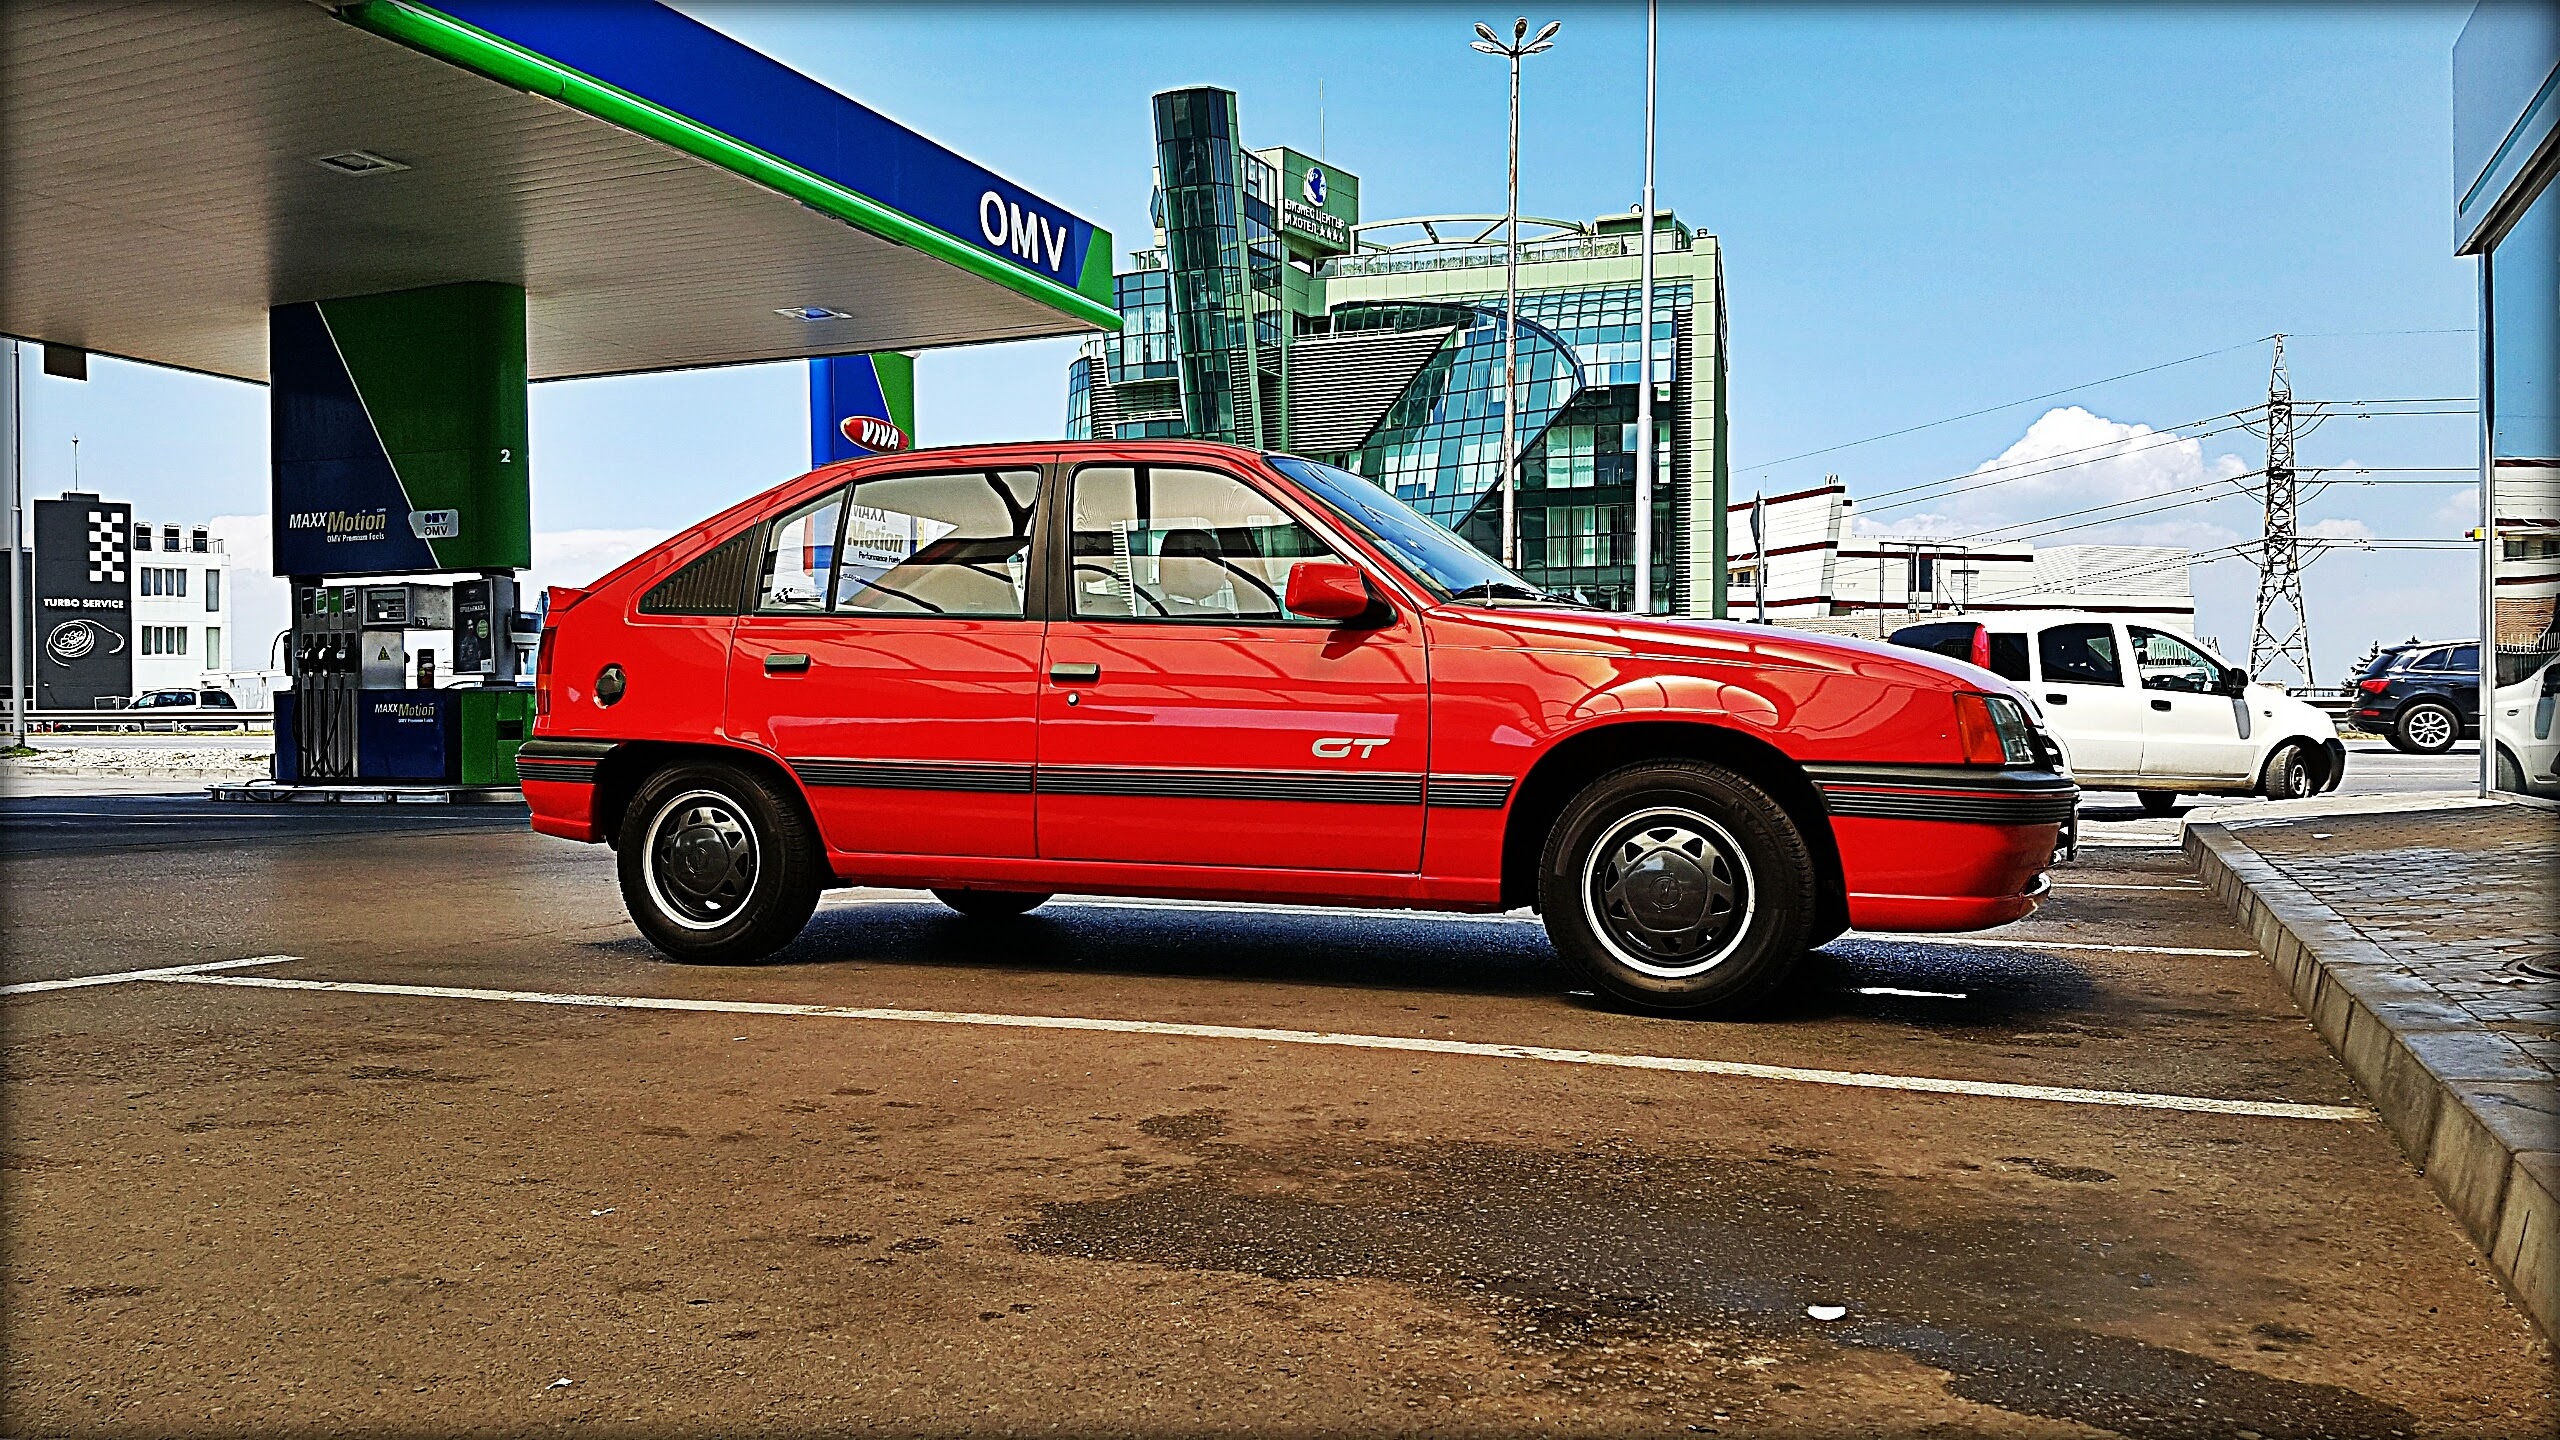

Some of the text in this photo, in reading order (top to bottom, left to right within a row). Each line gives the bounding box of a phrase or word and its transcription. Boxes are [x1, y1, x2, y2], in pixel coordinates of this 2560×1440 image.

[1284, 199, 1345, 229] БИЗНЕС ЦЕНТЪР
[1284, 212, 1317, 234] И ХОТЕЛ
[980, 191, 1066, 272] OMV
[861, 420, 899, 450] VIVA
[500, 449, 511, 462] 2
[289, 510, 386, 533] MAXX Motion
[424, 526, 448, 536] OMV
[848, 520, 904, 553] Motion
[43, 598, 124, 608] TURBO SERVICE
[375, 703, 435, 716] MAXX Motion
[1312, 738, 1390, 758] GT
